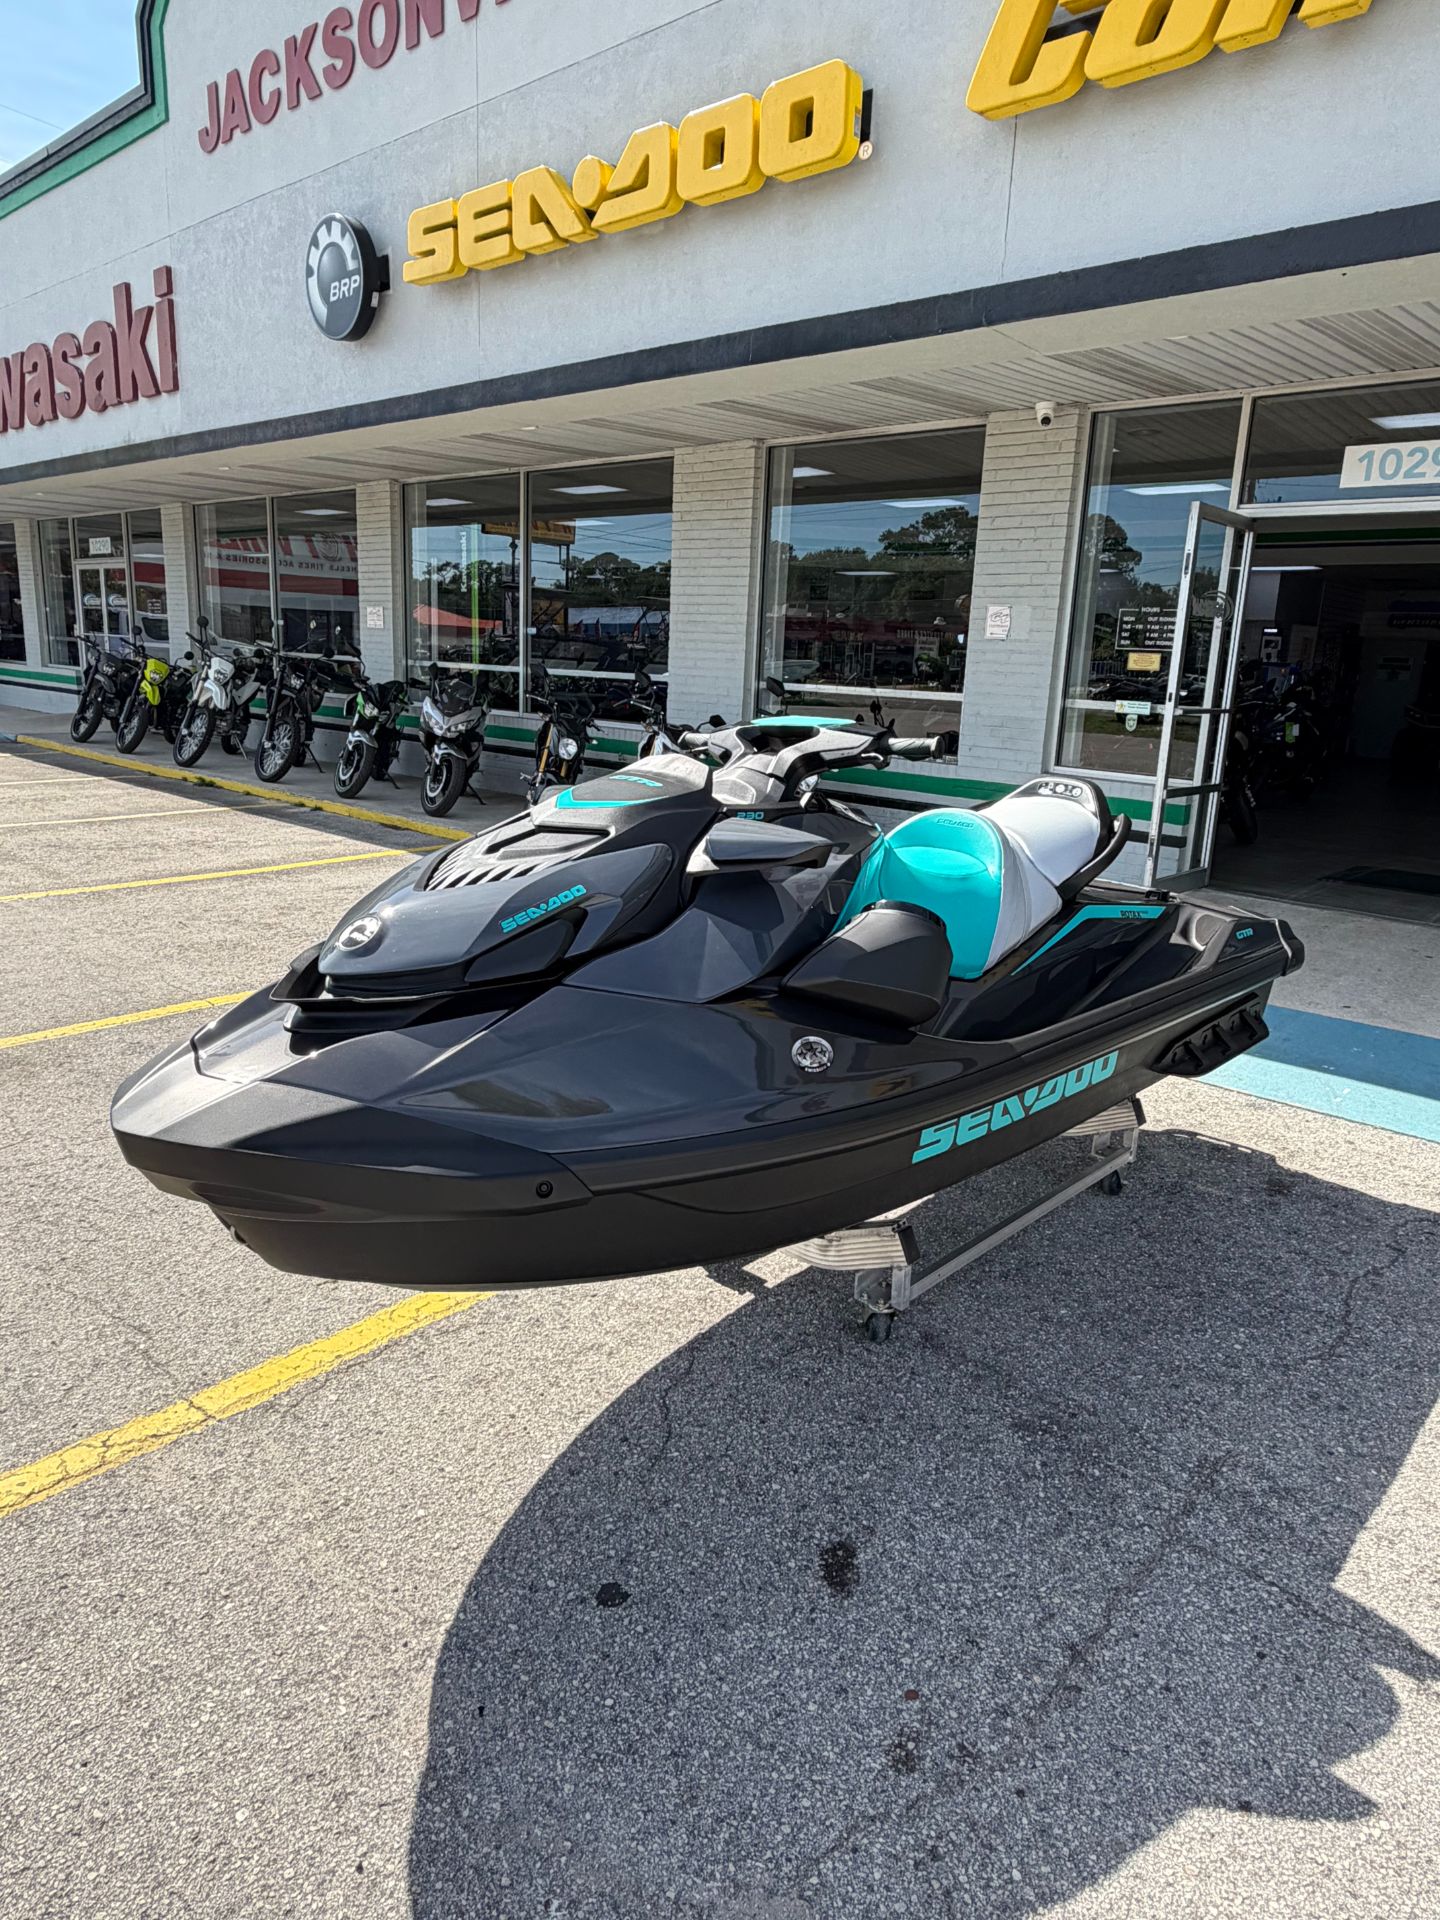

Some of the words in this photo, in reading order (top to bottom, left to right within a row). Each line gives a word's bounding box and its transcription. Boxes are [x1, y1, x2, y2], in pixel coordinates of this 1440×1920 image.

[198, 0, 510, 153] JACKSON
[328, 273, 361, 303] BRP
[736, 811, 765, 821] 230
[1235, 927, 1254, 940] GTR
